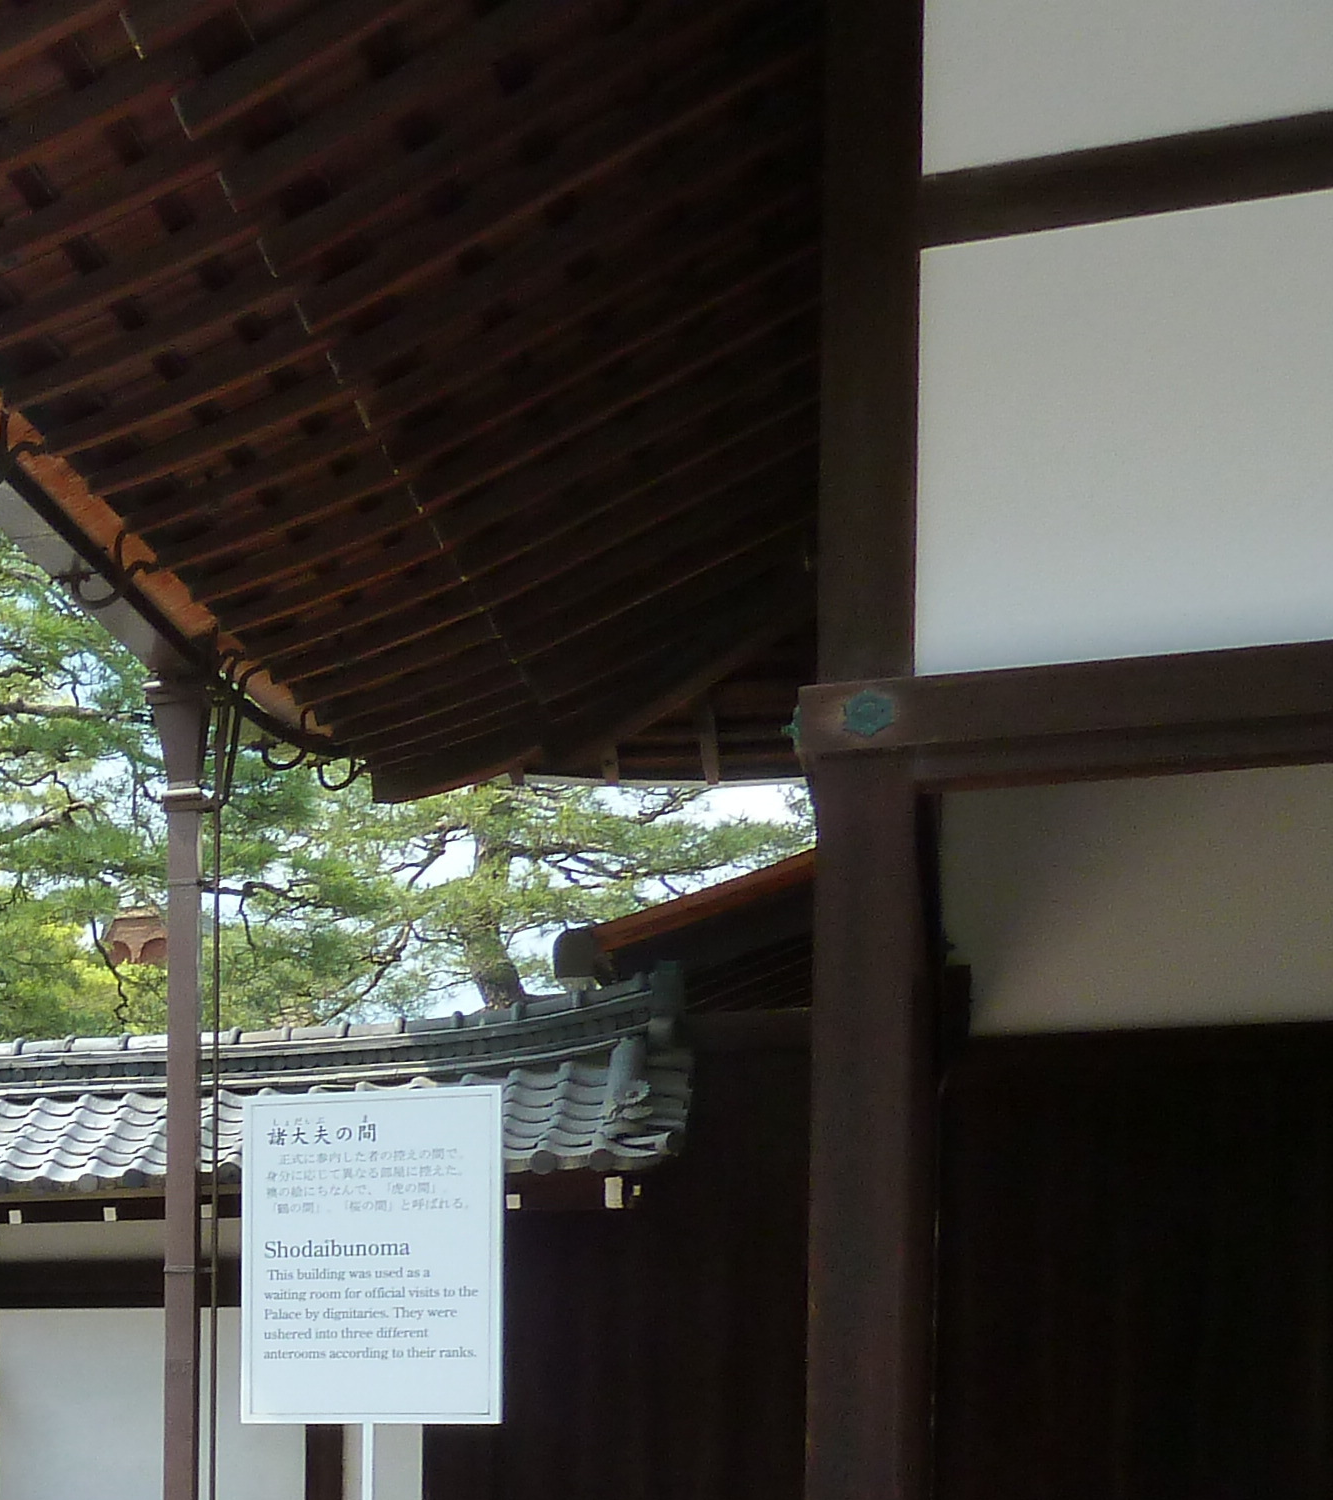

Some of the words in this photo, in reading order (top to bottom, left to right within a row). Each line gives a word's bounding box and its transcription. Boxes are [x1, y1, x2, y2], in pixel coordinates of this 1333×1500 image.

[267, 1123, 378, 1146] 諸大夫の間
[264, 1239, 411, 1259] Shodaibunoma
[267, 1269, 294, 1281] This
[297, 1268, 346, 1281] building
[349, 1270, 371, 1279] was
[375, 1267, 403, 1279] used
[407, 1270, 420, 1278] as
[423, 1269, 431, 1278] a
[264, 1289, 307, 1301] waiting
[310, 1290, 341, 1299] room
[345, 1288, 362, 1299] for
[365, 1286, 405, 1299] official
[409, 1286, 440, 1298] visits
[443, 1287, 455, 1298] to
[458, 1286, 478, 1297] the
[264, 1308, 302, 1320] Palace
[305, 1308, 320, 1322] by
[323, 1307, 389, 1321] dignitaries.
[393, 1306, 424, 1320] They
[427, 1308, 458, 1318] were
[264, 1328, 312, 1340] ushered
[315, 1328, 338, 1339] into
[341, 1328, 373, 1339] three
[376, 1327, 429, 1339] different
[263, 1349, 326, 1359] anterooms
[329, 1347, 388, 1360] according
[392, 1348, 404, 1359] to
[407, 1347, 436, 1358] their
[439, 1346, 477, 1358] ranks.
